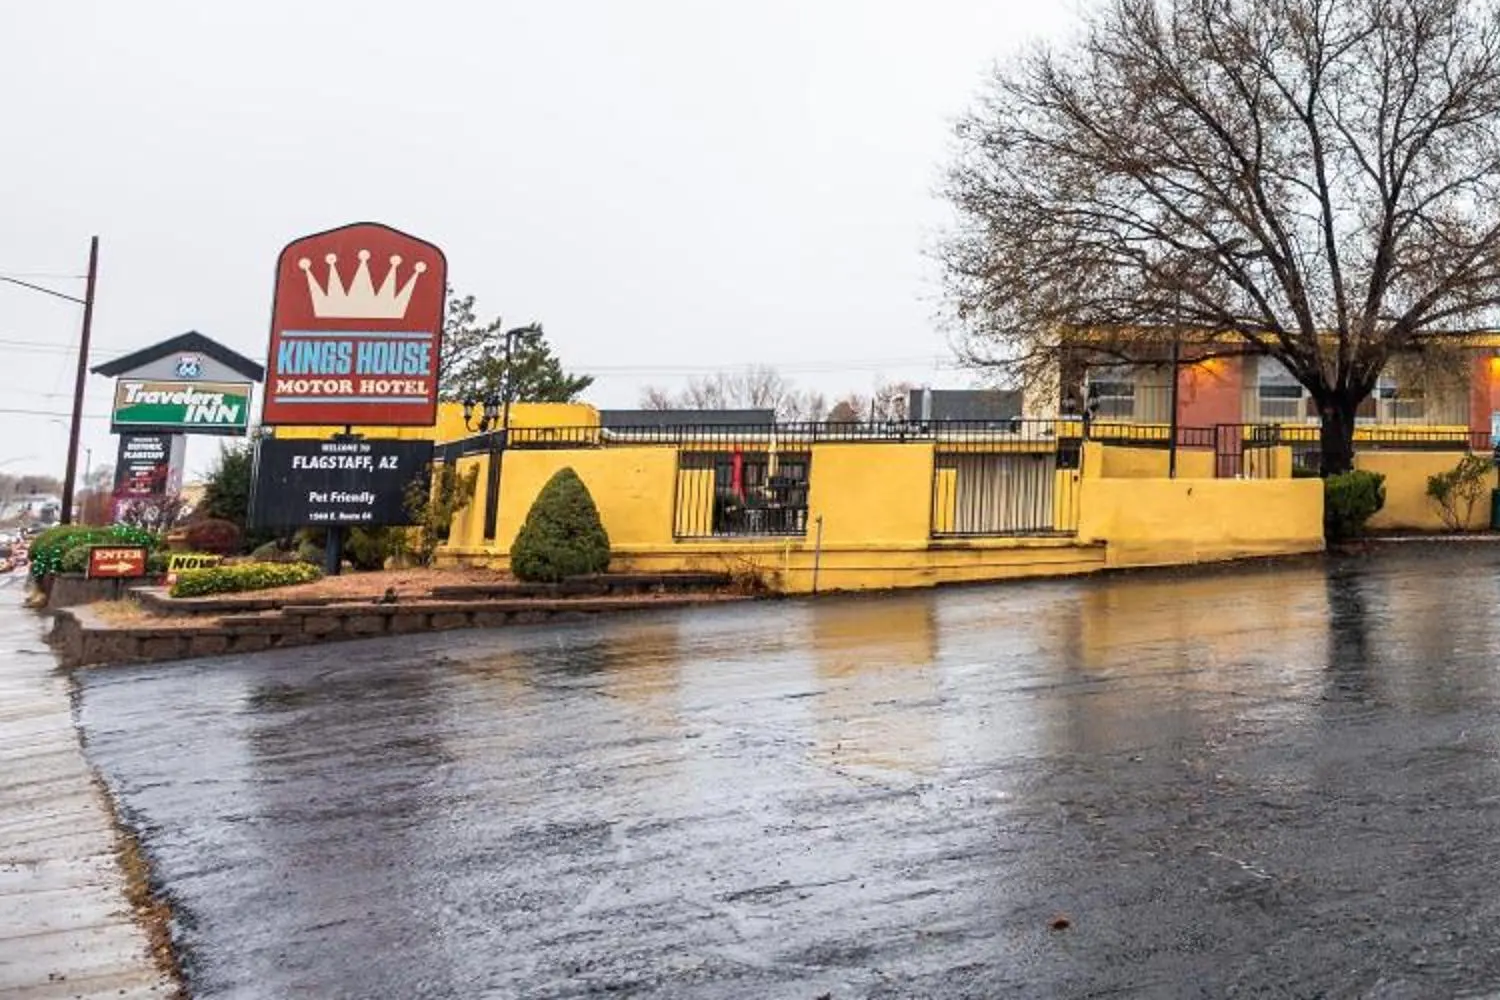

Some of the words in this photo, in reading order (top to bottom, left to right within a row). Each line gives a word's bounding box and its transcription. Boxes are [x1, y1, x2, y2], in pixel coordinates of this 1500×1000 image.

[278, 341, 352, 375] KINGS
[356, 341, 432, 376] HOUSE
[125, 383, 224, 404] Travelers
[276, 379, 353, 395] MOTOR
[359, 379, 429, 395] HOTEL
[183, 405, 240, 423] INN
[292, 456, 374, 472] FLAGSTAFF,
[379, 456, 399, 469] AZ
[308, 491, 327, 503] Pet
[330, 491, 375, 505] Friendly
[95, 549, 142, 560] ENTER
